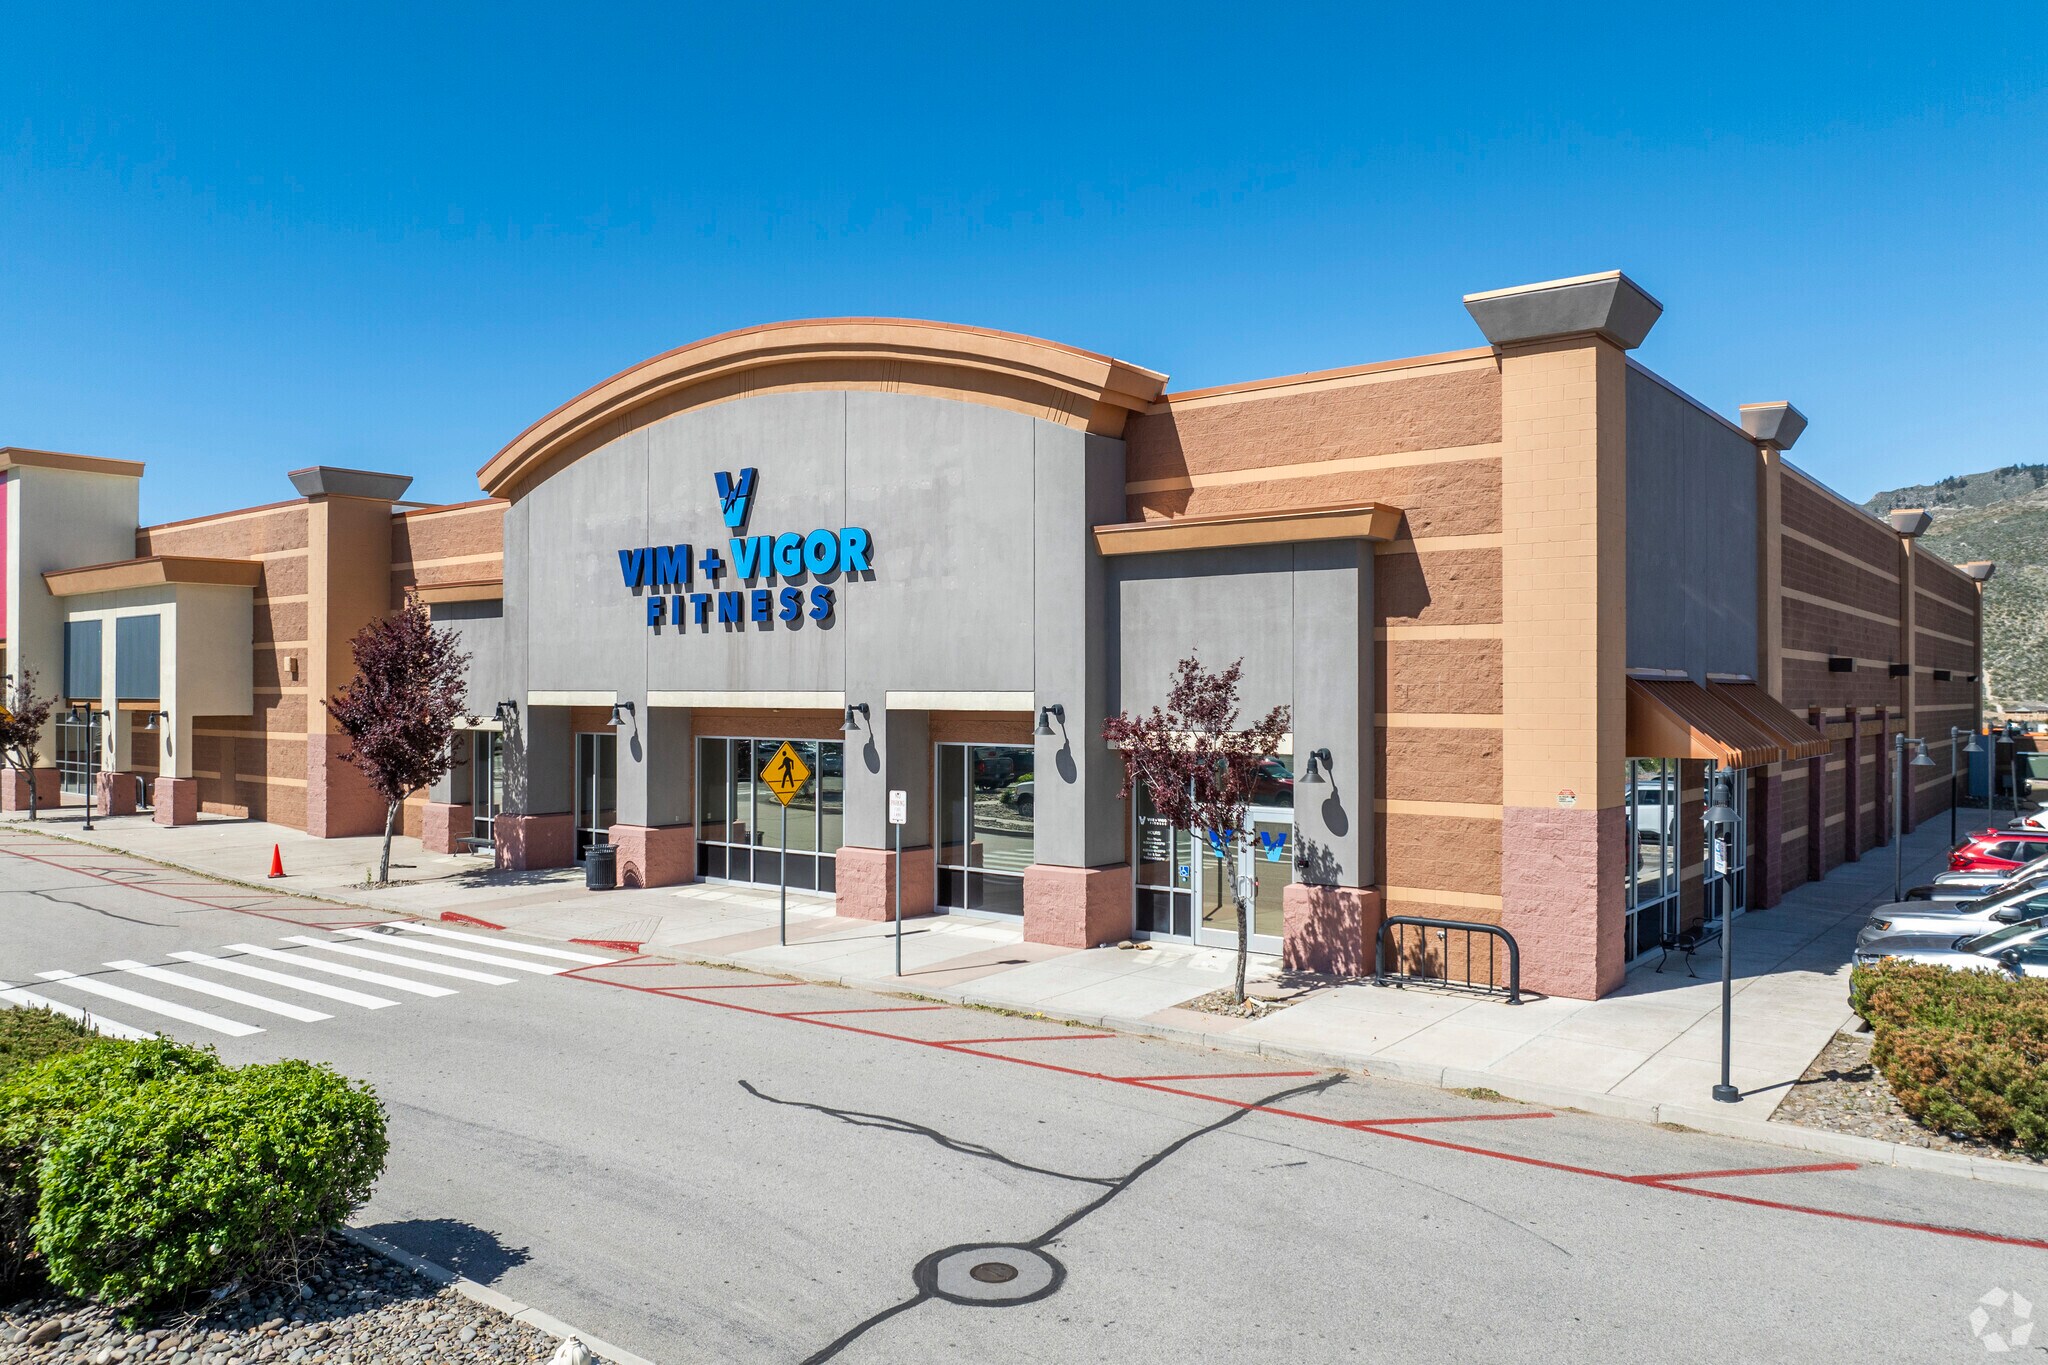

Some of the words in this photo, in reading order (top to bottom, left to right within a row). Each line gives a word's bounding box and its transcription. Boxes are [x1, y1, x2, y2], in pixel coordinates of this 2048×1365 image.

[618, 544, 692, 587] VIM
[729, 527, 870, 579] VIGOR
[647, 585, 830, 627] FITNESS
